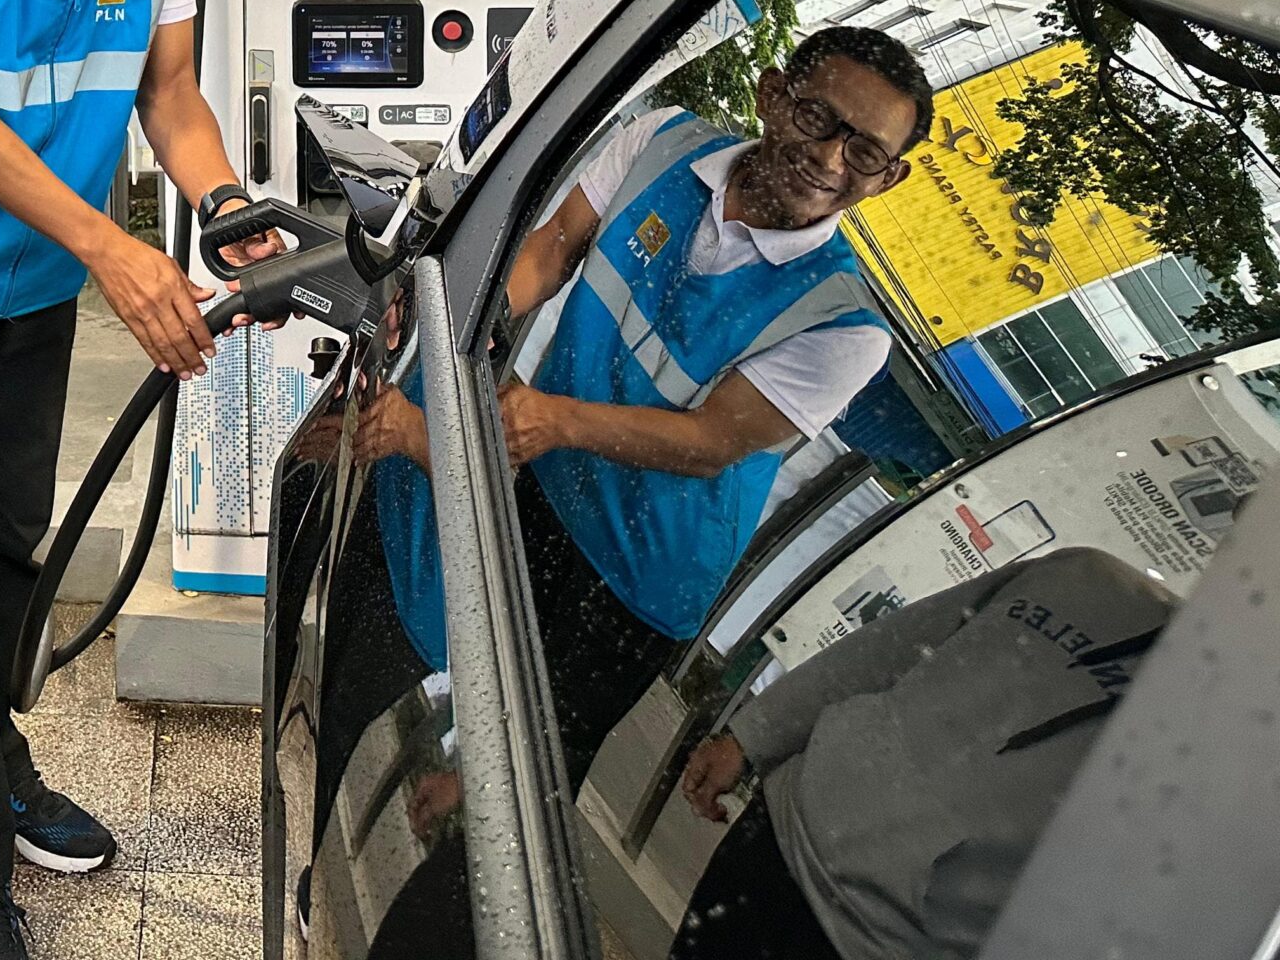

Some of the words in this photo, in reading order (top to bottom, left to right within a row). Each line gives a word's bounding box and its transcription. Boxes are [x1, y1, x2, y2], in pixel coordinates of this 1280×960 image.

[95, 8, 125, 22] PLN
[383, 109, 393, 120] C
[400, 111, 414, 119] AC
